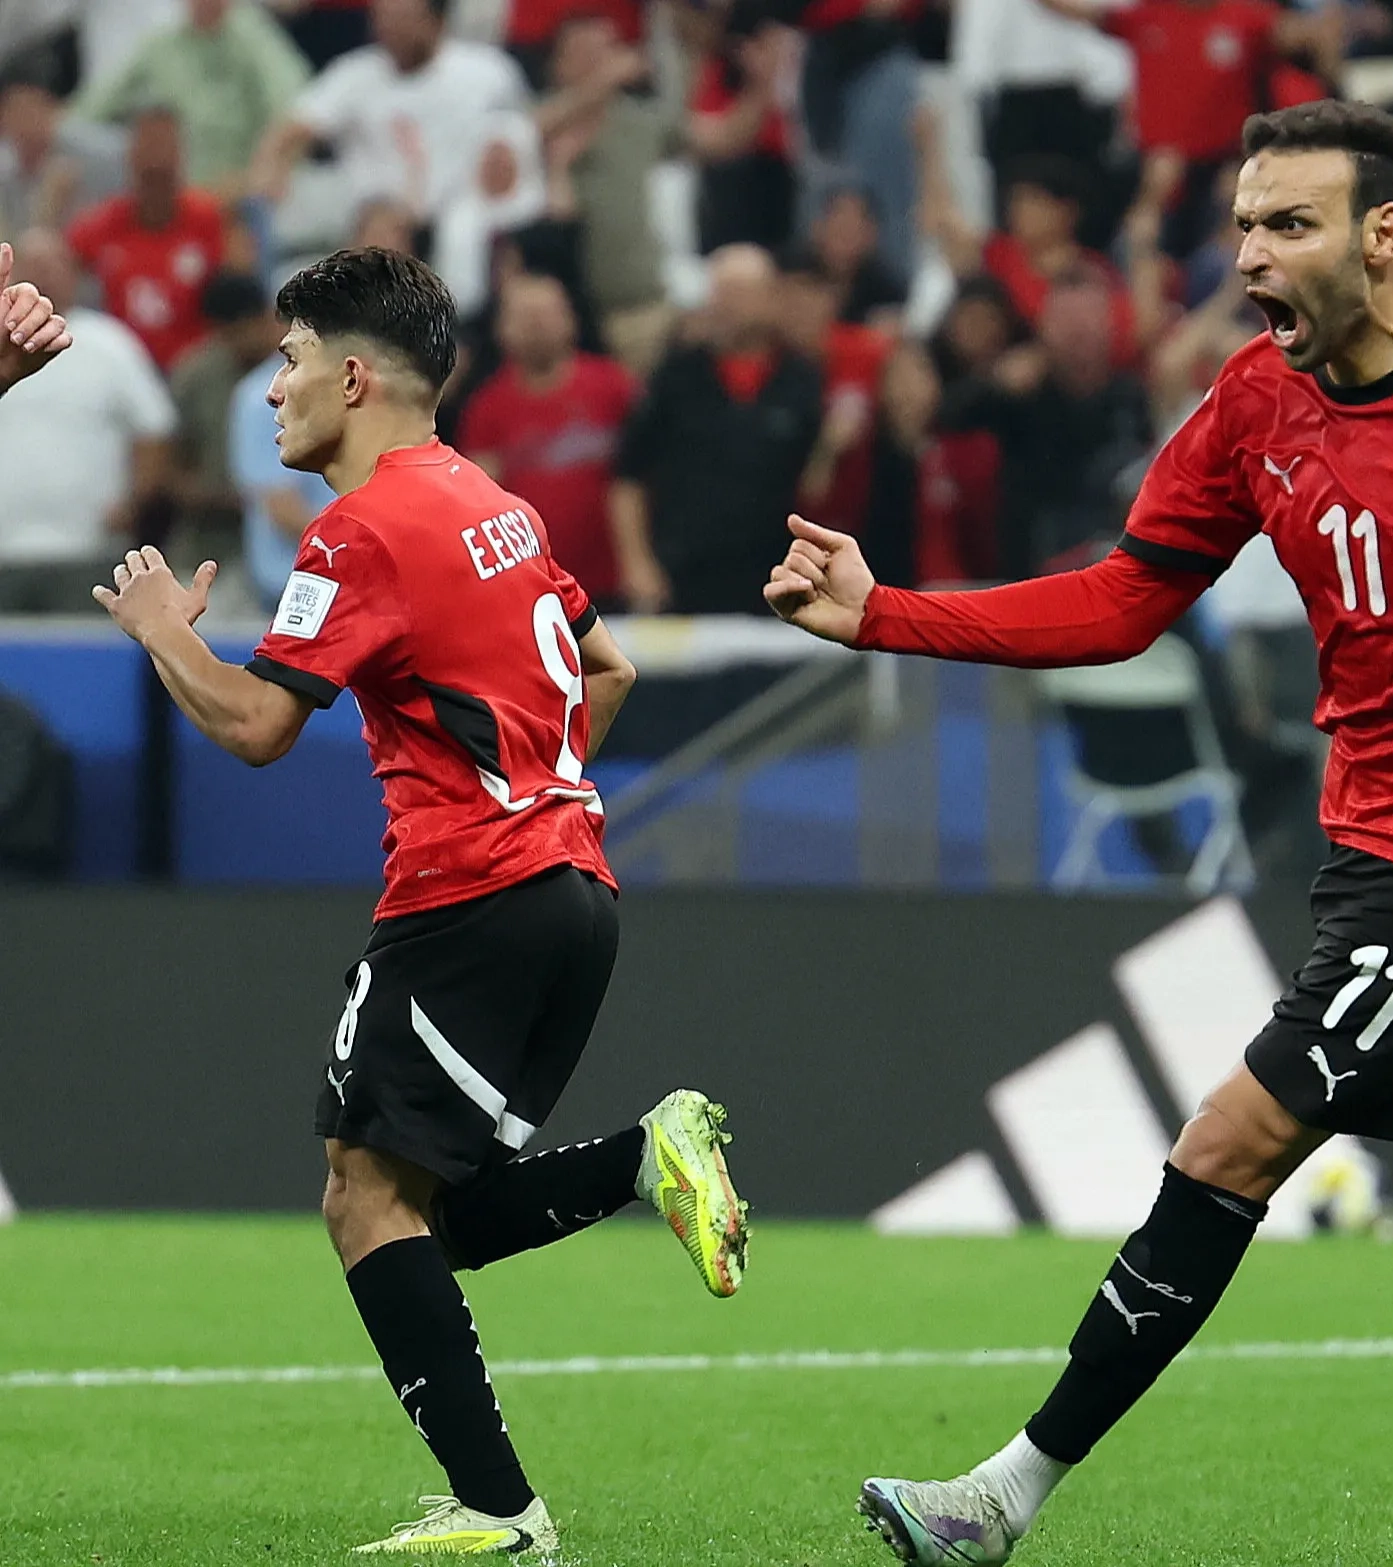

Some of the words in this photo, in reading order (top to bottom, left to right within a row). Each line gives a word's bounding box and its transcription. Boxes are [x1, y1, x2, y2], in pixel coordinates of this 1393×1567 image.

[461, 508, 540, 580] E.EISSA
[1318, 504, 1387, 617] 11
[335, 960, 371, 1061] 8
